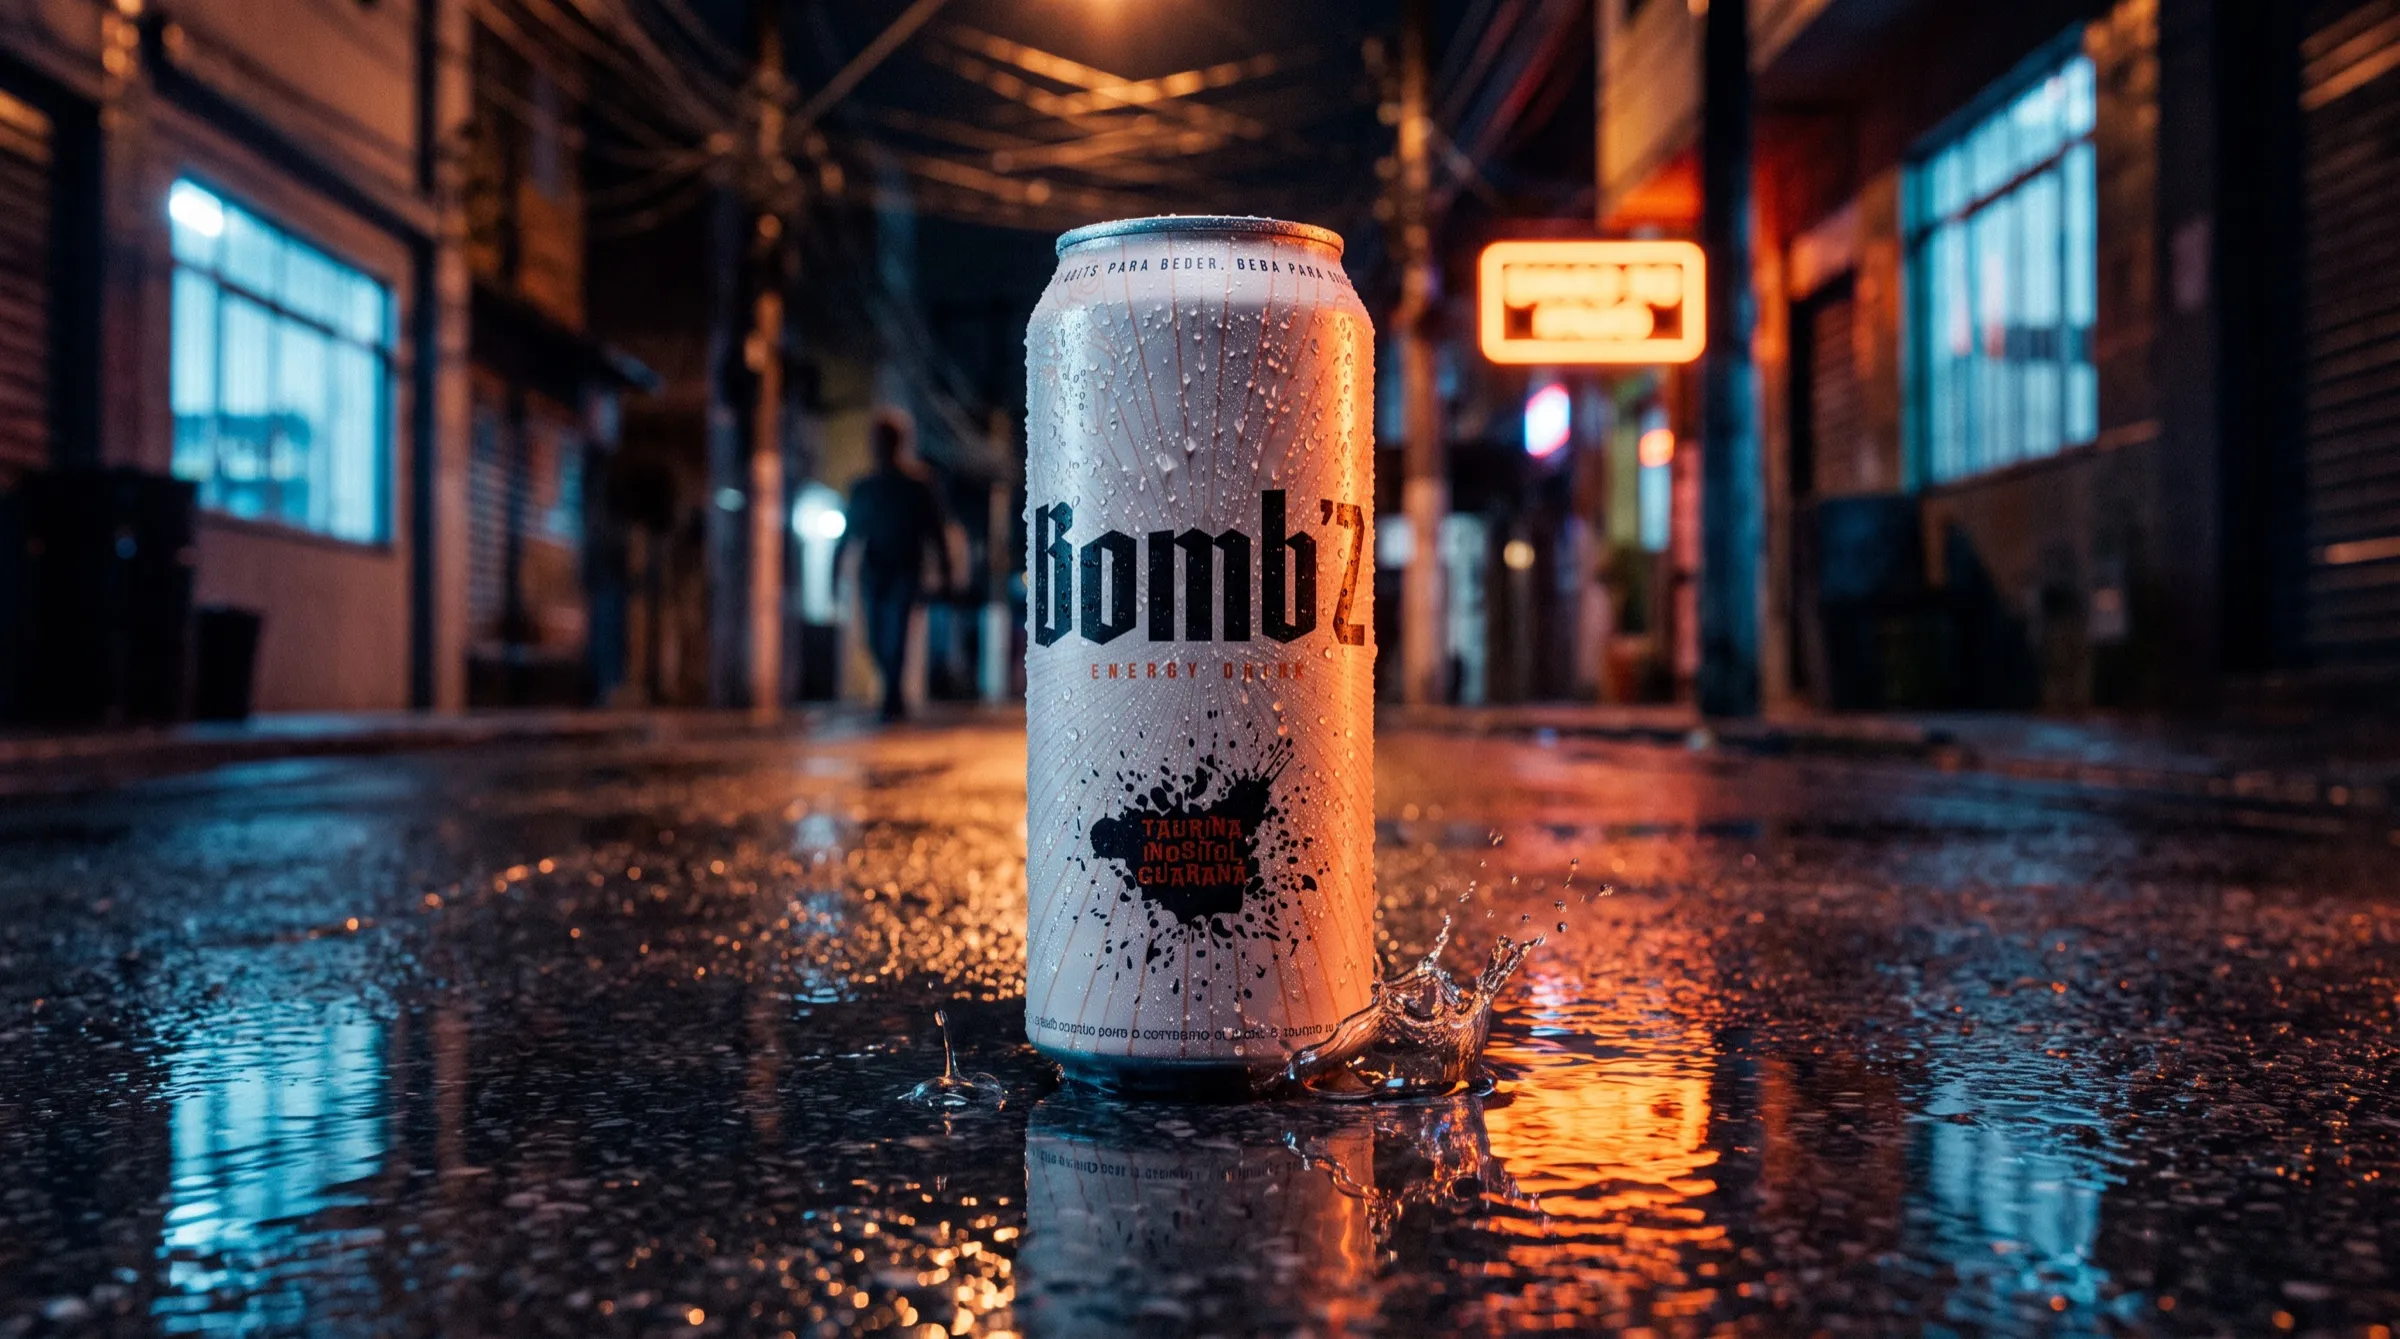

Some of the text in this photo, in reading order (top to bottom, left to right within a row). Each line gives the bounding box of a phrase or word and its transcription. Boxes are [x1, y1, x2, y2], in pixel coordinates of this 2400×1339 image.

[1108, 259, 1148, 274] PARA
[1237, 257, 1280, 273] BEBA
[1288, 262, 1323, 280] PARA
[1091, 663, 1197, 680] ENERGY
[1141, 815, 1242, 839] TAURINA
[1143, 841, 1242, 862] INOSITOL
